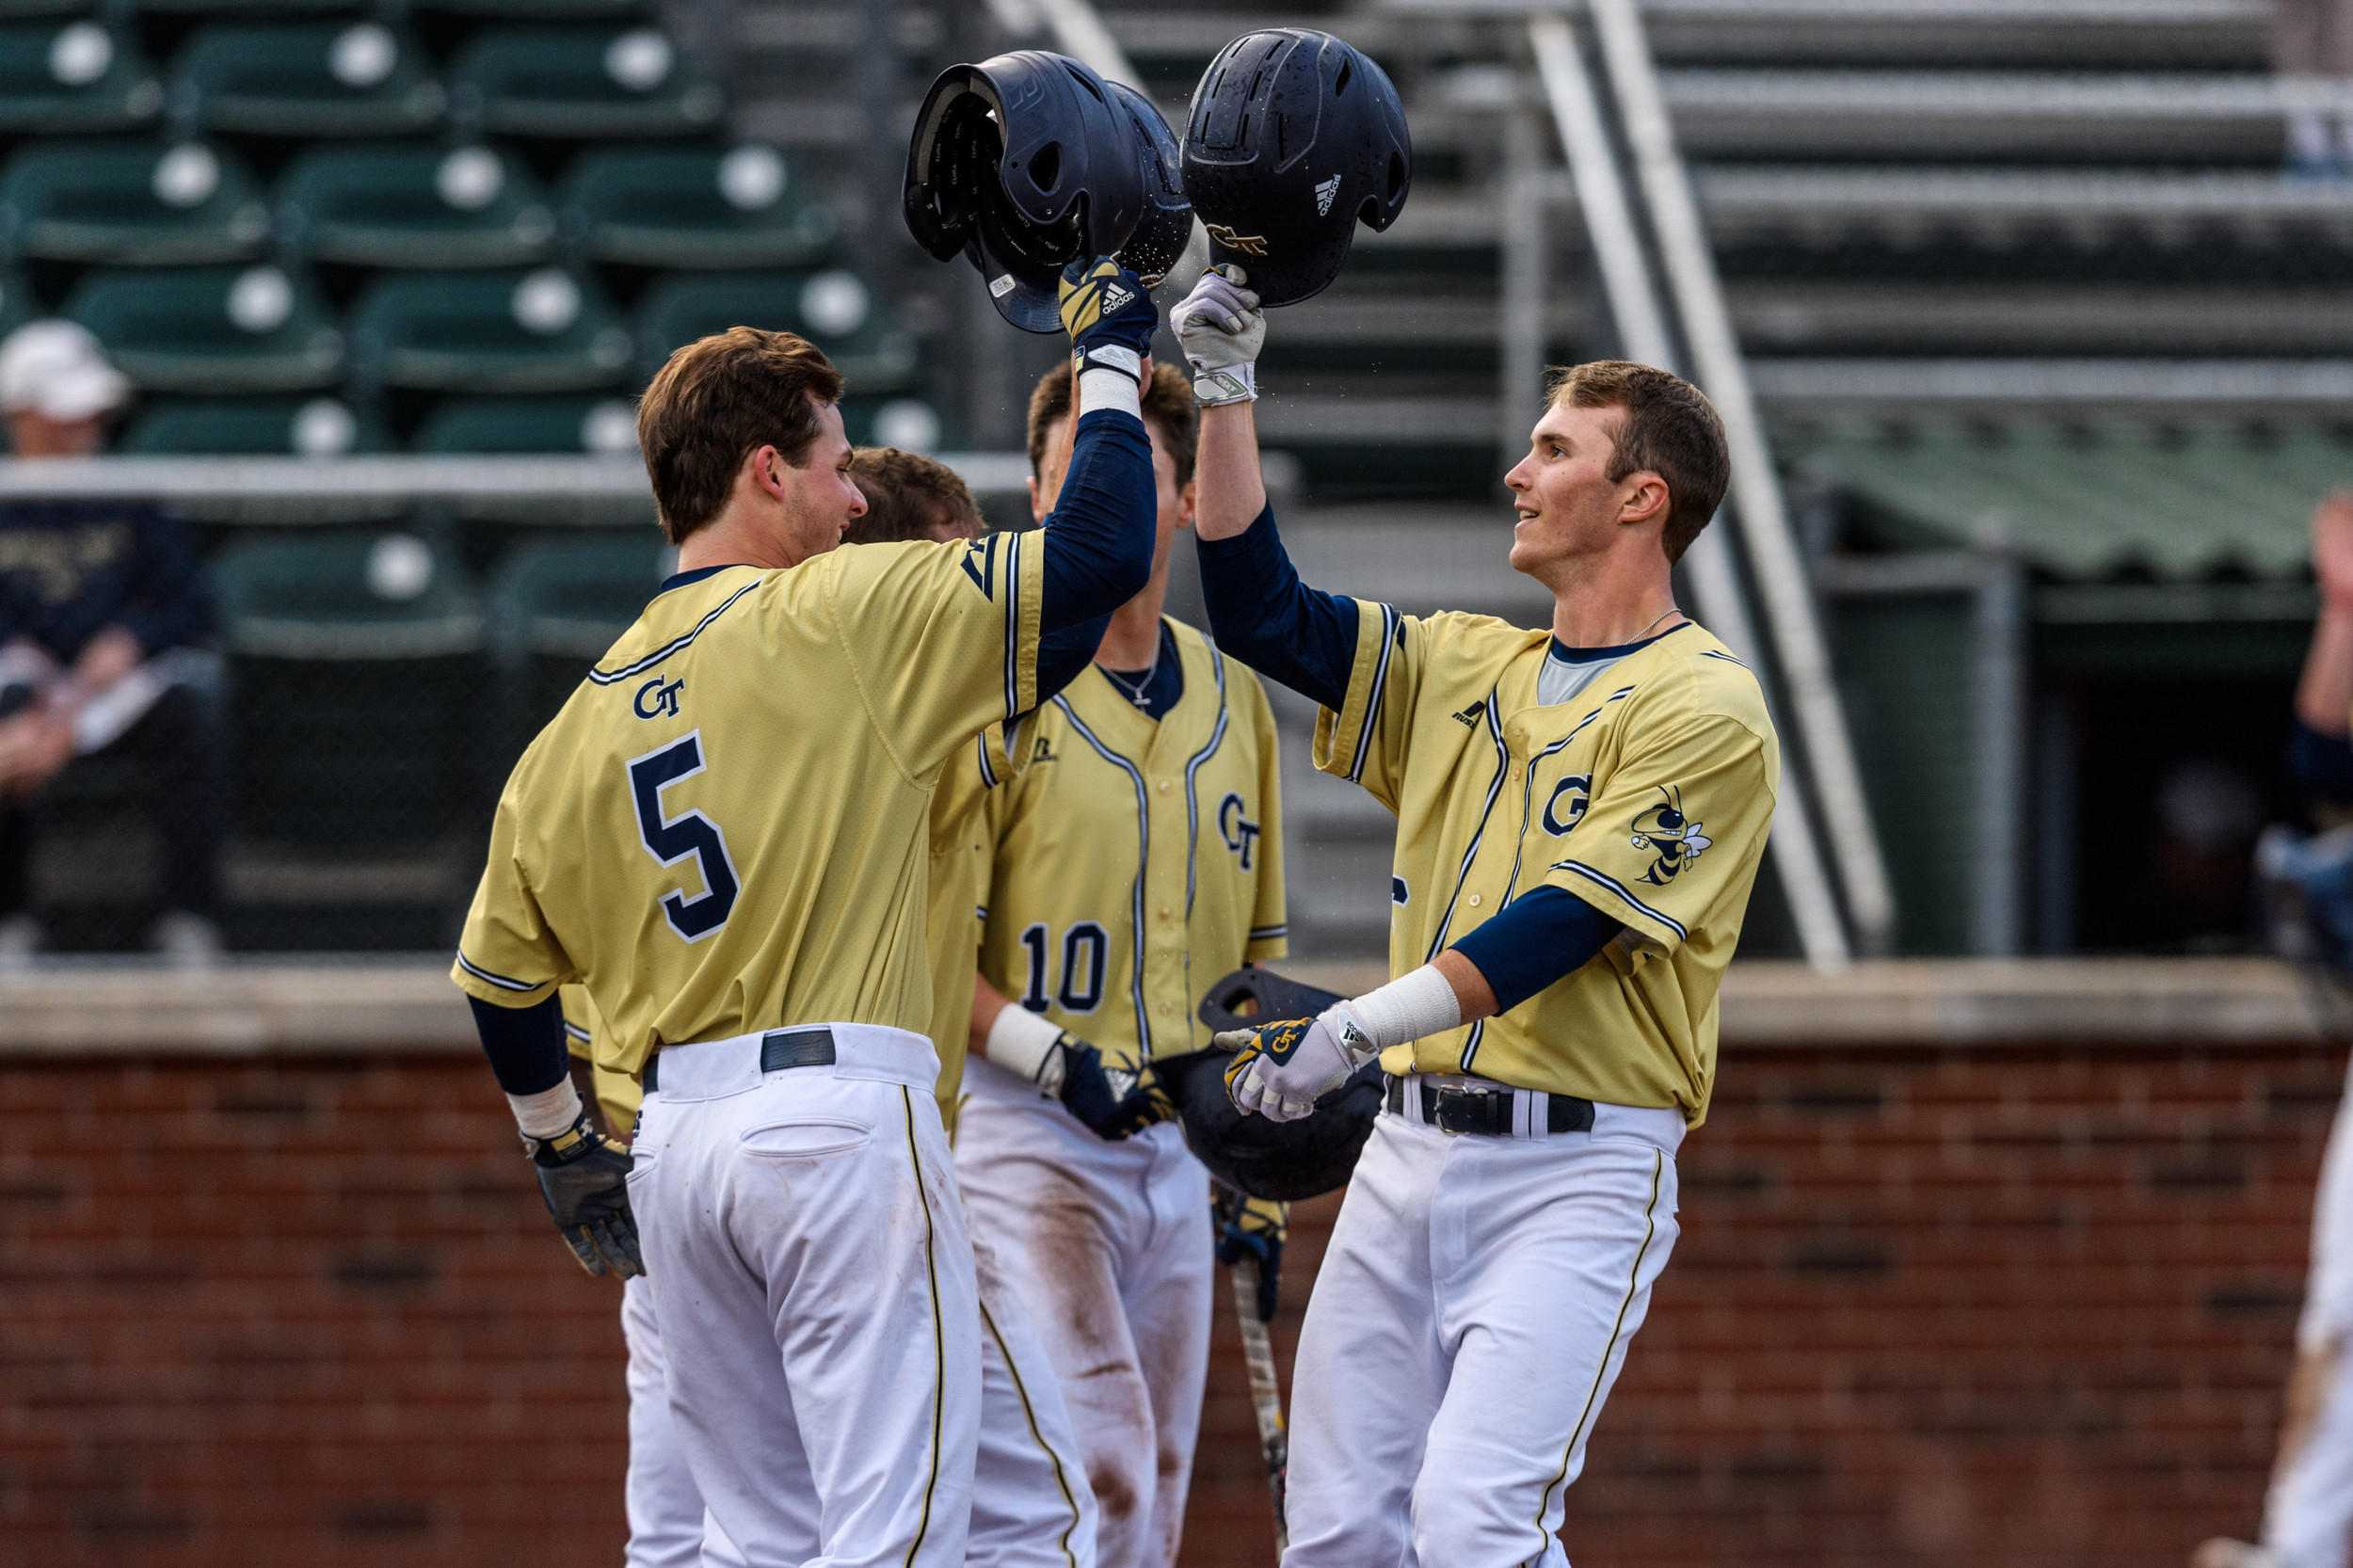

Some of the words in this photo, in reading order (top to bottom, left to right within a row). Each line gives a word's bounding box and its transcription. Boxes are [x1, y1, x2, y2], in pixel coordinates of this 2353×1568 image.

[1320, 173, 1341, 216] adidas
[1206, 224, 1268, 255] GT
[1102, 291, 1135, 314] adidas
[633, 673, 685, 721] GT
[625, 728, 742, 944] 5
[1217, 791, 1261, 872] GT
[1019, 920, 1110, 1015] 10
[1272, 1029, 1298, 1053] GT
